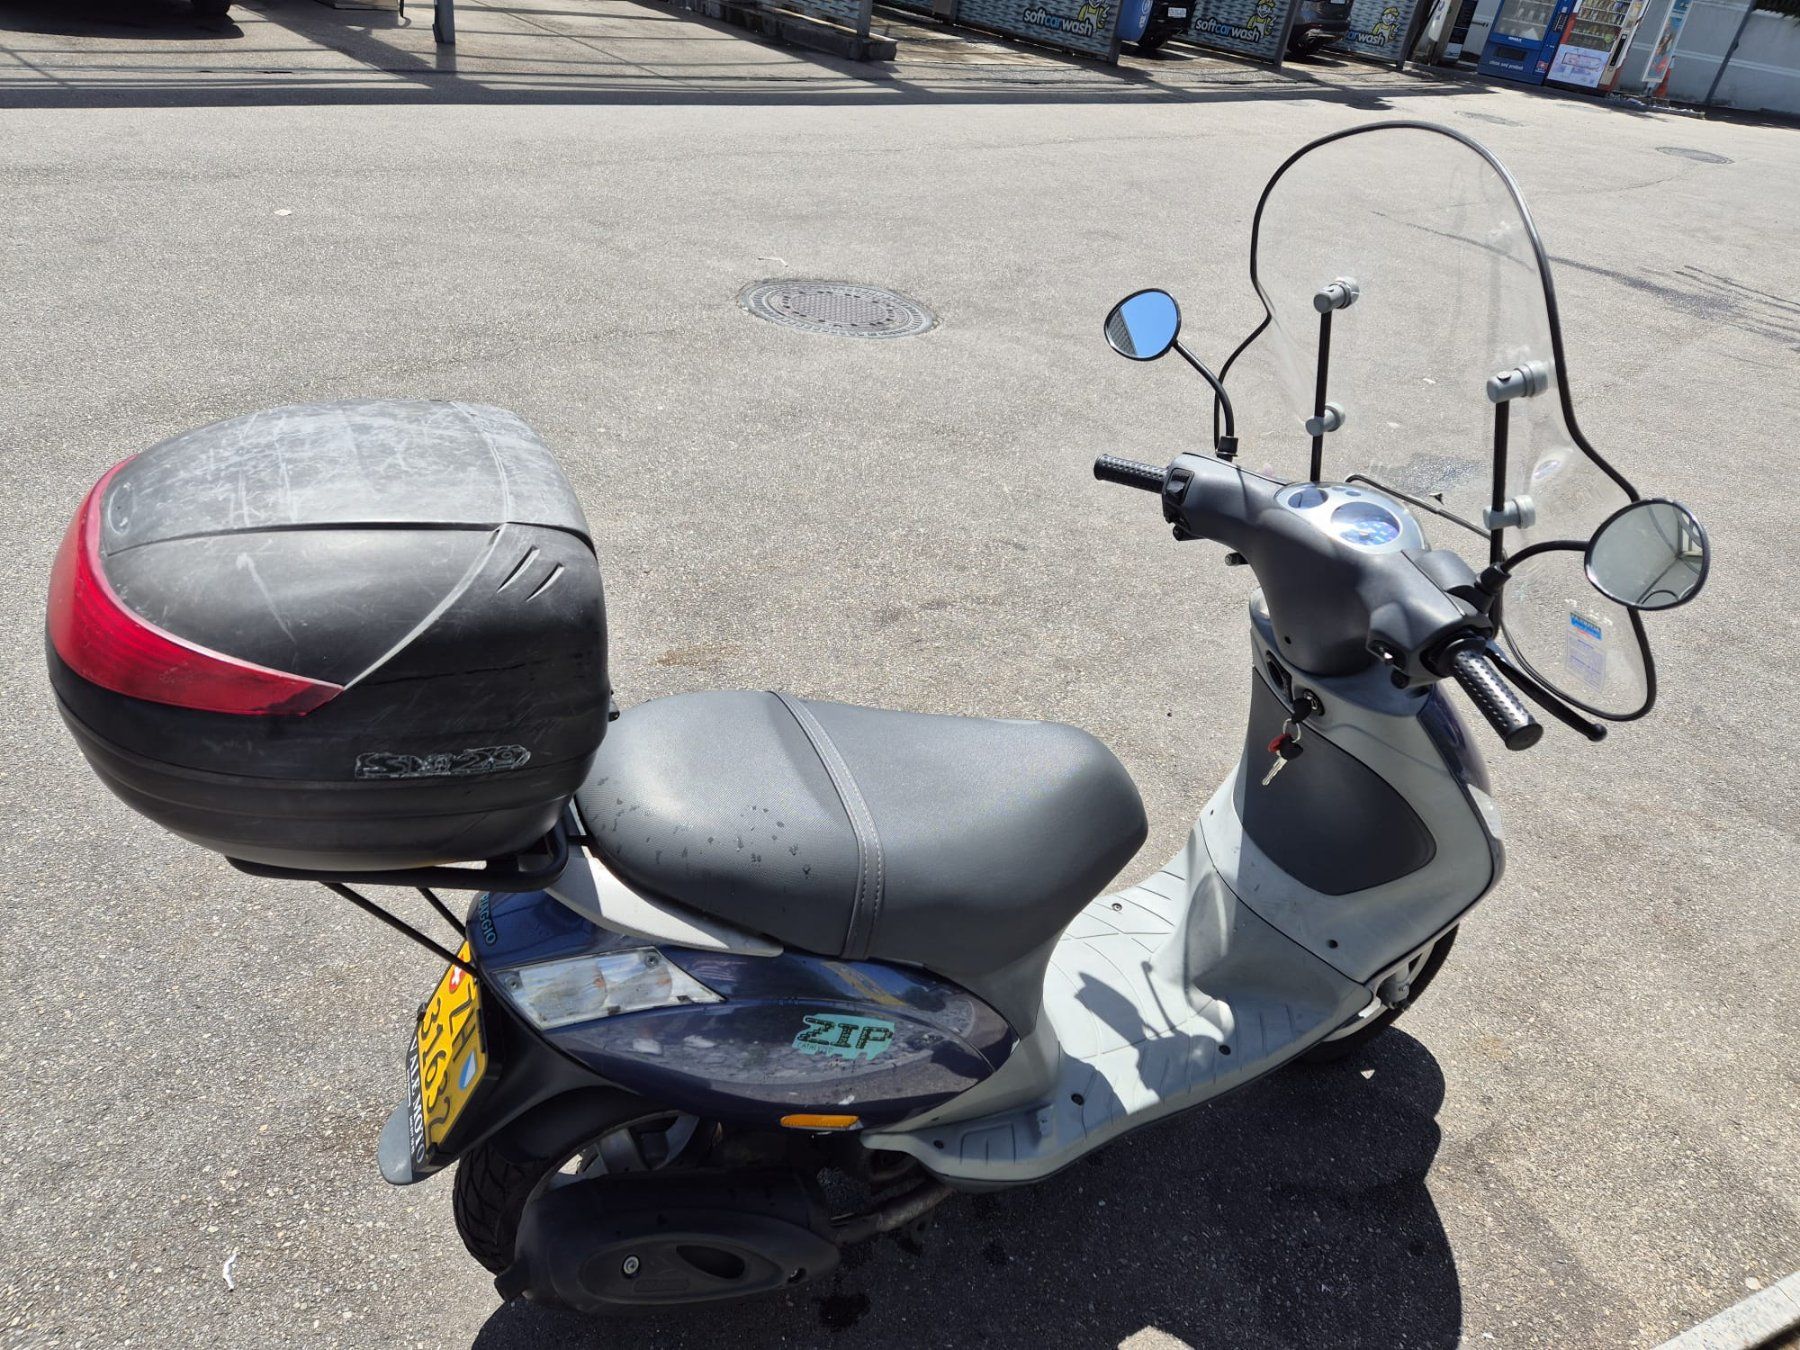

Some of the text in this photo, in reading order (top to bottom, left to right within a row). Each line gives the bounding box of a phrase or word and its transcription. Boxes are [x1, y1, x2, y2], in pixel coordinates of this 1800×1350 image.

[1023, 8, 1093, 37] softcarwash
[1195, 18, 1260, 41] softcarwash
[479, 894, 497, 945] PIAGGIO
[449, 983, 475, 1062] ZH
[797, 1016, 894, 1050] ZIP
[408, 1035, 421, 1096] VALE
[420, 997, 450, 1144] 31632
[410, 1099, 424, 1164] MOTO
